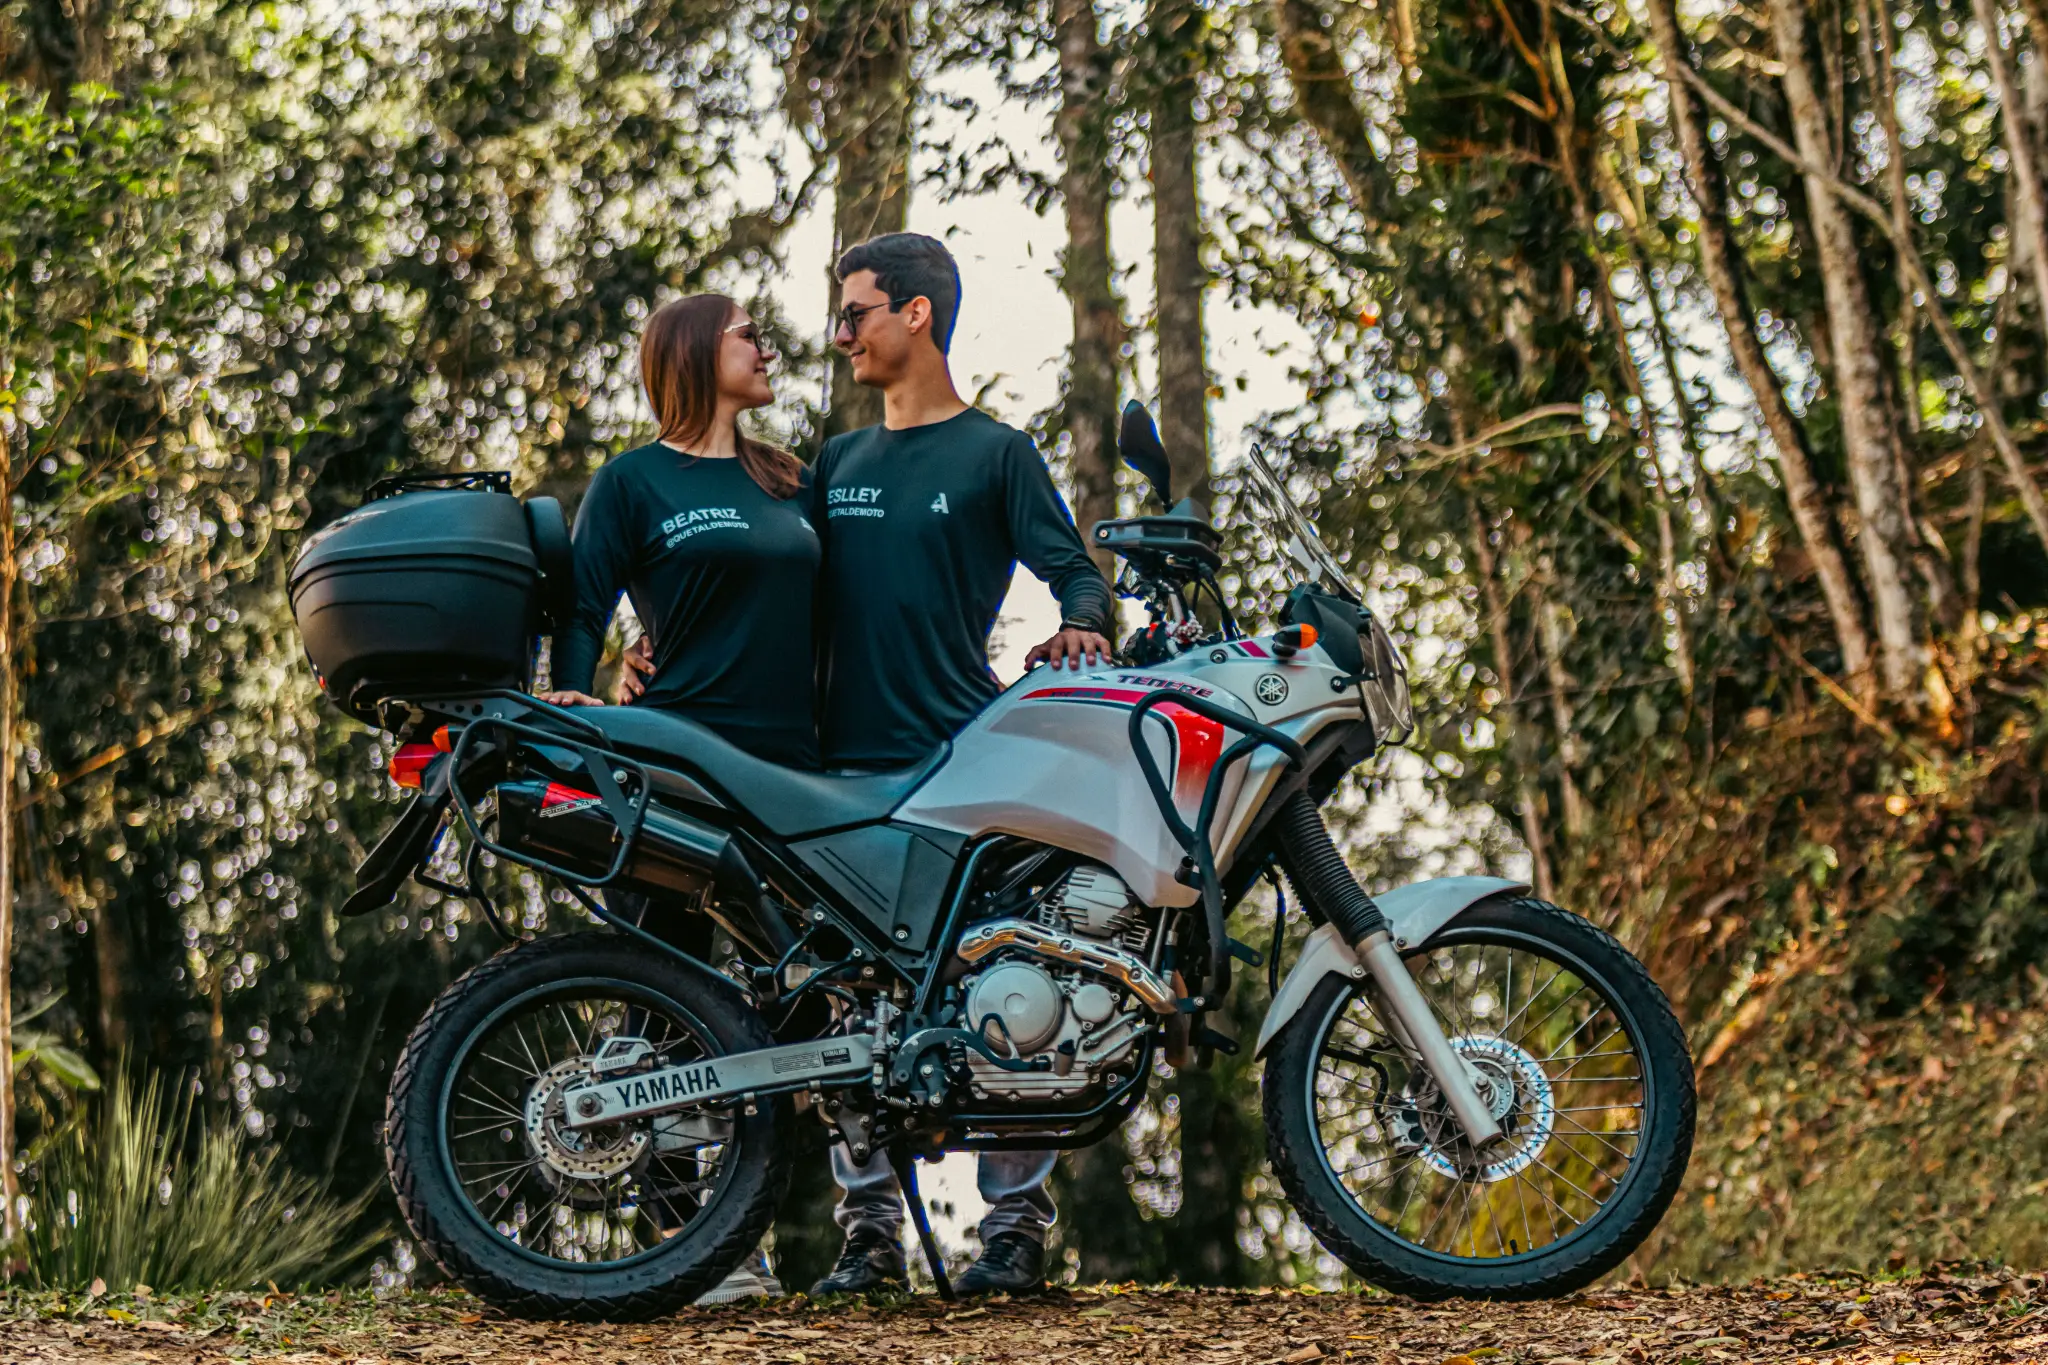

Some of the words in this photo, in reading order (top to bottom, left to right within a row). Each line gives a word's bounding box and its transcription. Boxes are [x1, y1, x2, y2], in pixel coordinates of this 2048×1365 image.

[662, 508, 741, 535] BEATRIZ
[666, 521, 750, 548] @QUETALDEMOTO
[615, 1065, 721, 1109] YAMAHA
